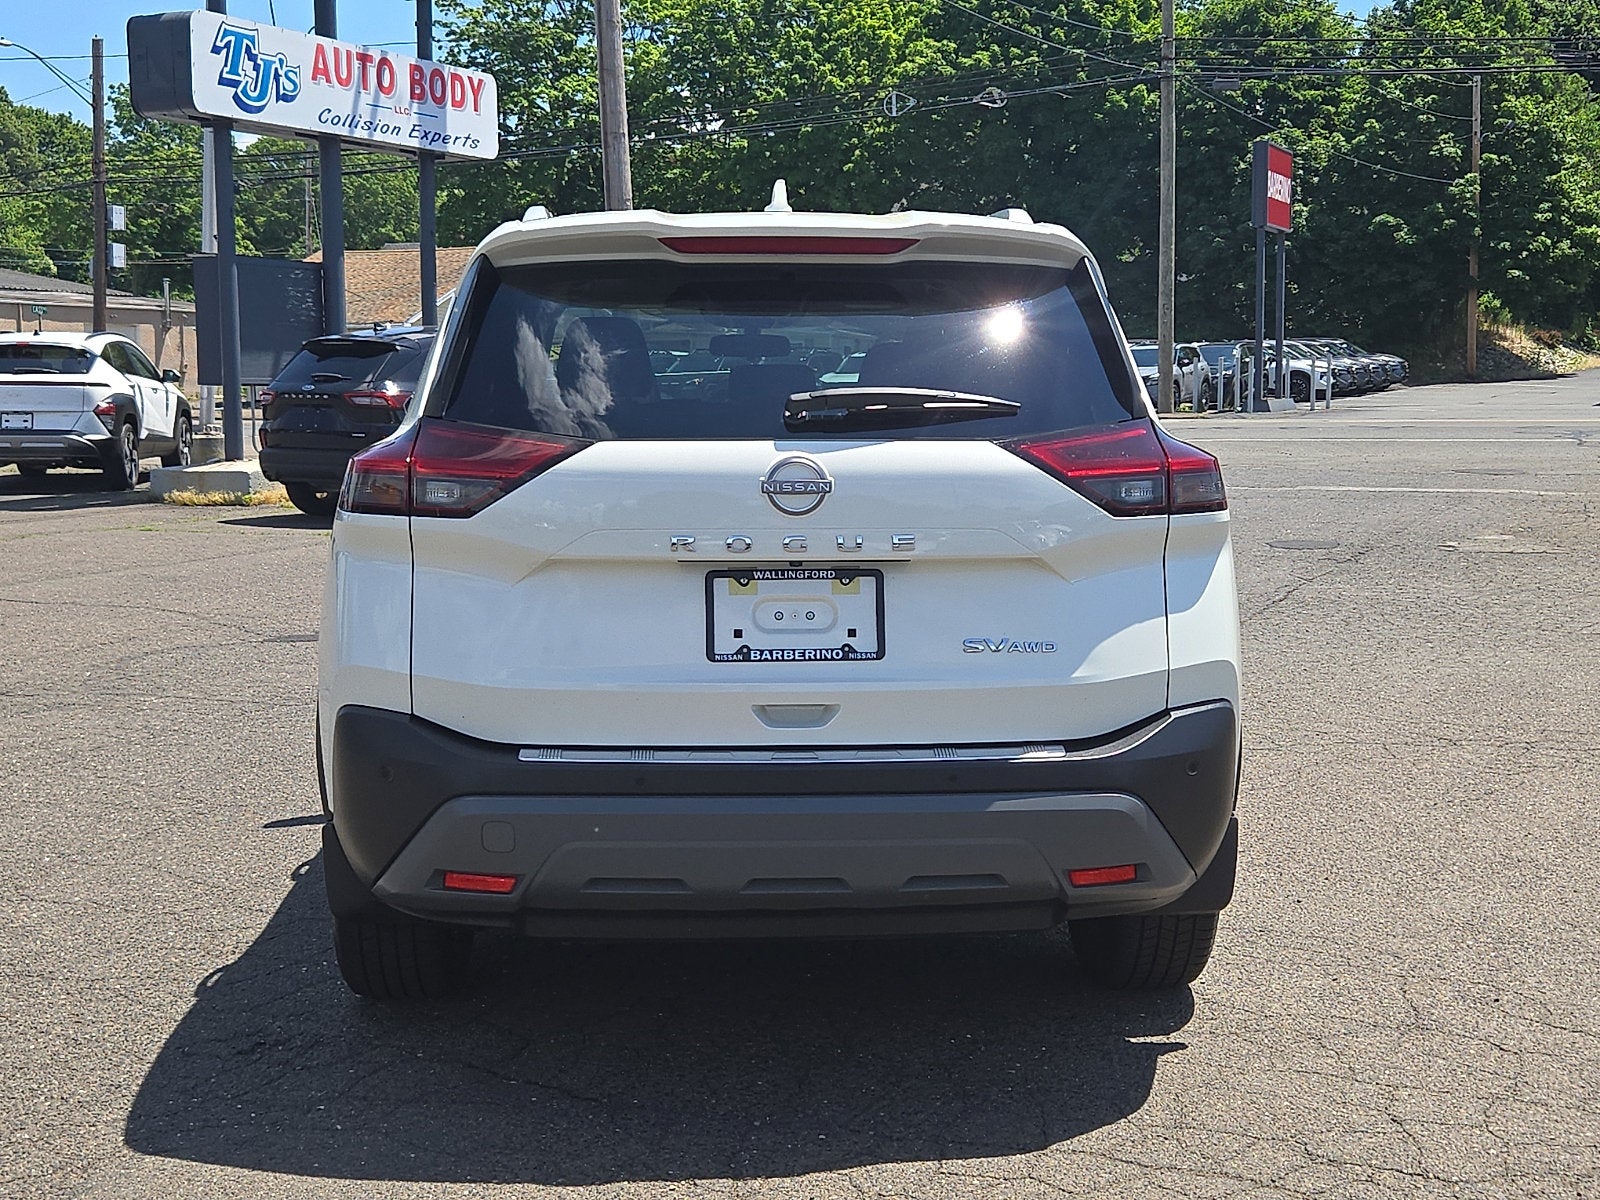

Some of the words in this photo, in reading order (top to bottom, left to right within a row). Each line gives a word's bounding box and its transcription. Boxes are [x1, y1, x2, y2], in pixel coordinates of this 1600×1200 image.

[210, 21, 300, 114] TJ's
[311, 42, 396, 96] AUTO
[409, 63, 484, 113] BODY
[318, 108, 401, 136] Collision
[408, 123, 481, 149] Experts
[763, 482, 831, 492] NISSAN
[670, 534, 916, 554] ROGUE
[752, 570, 836, 579] WALLINGFORD
[963, 637, 1009, 653] SV
[1007, 641, 1057, 653] AWD
[750, 650, 844, 660] BARBERINO
